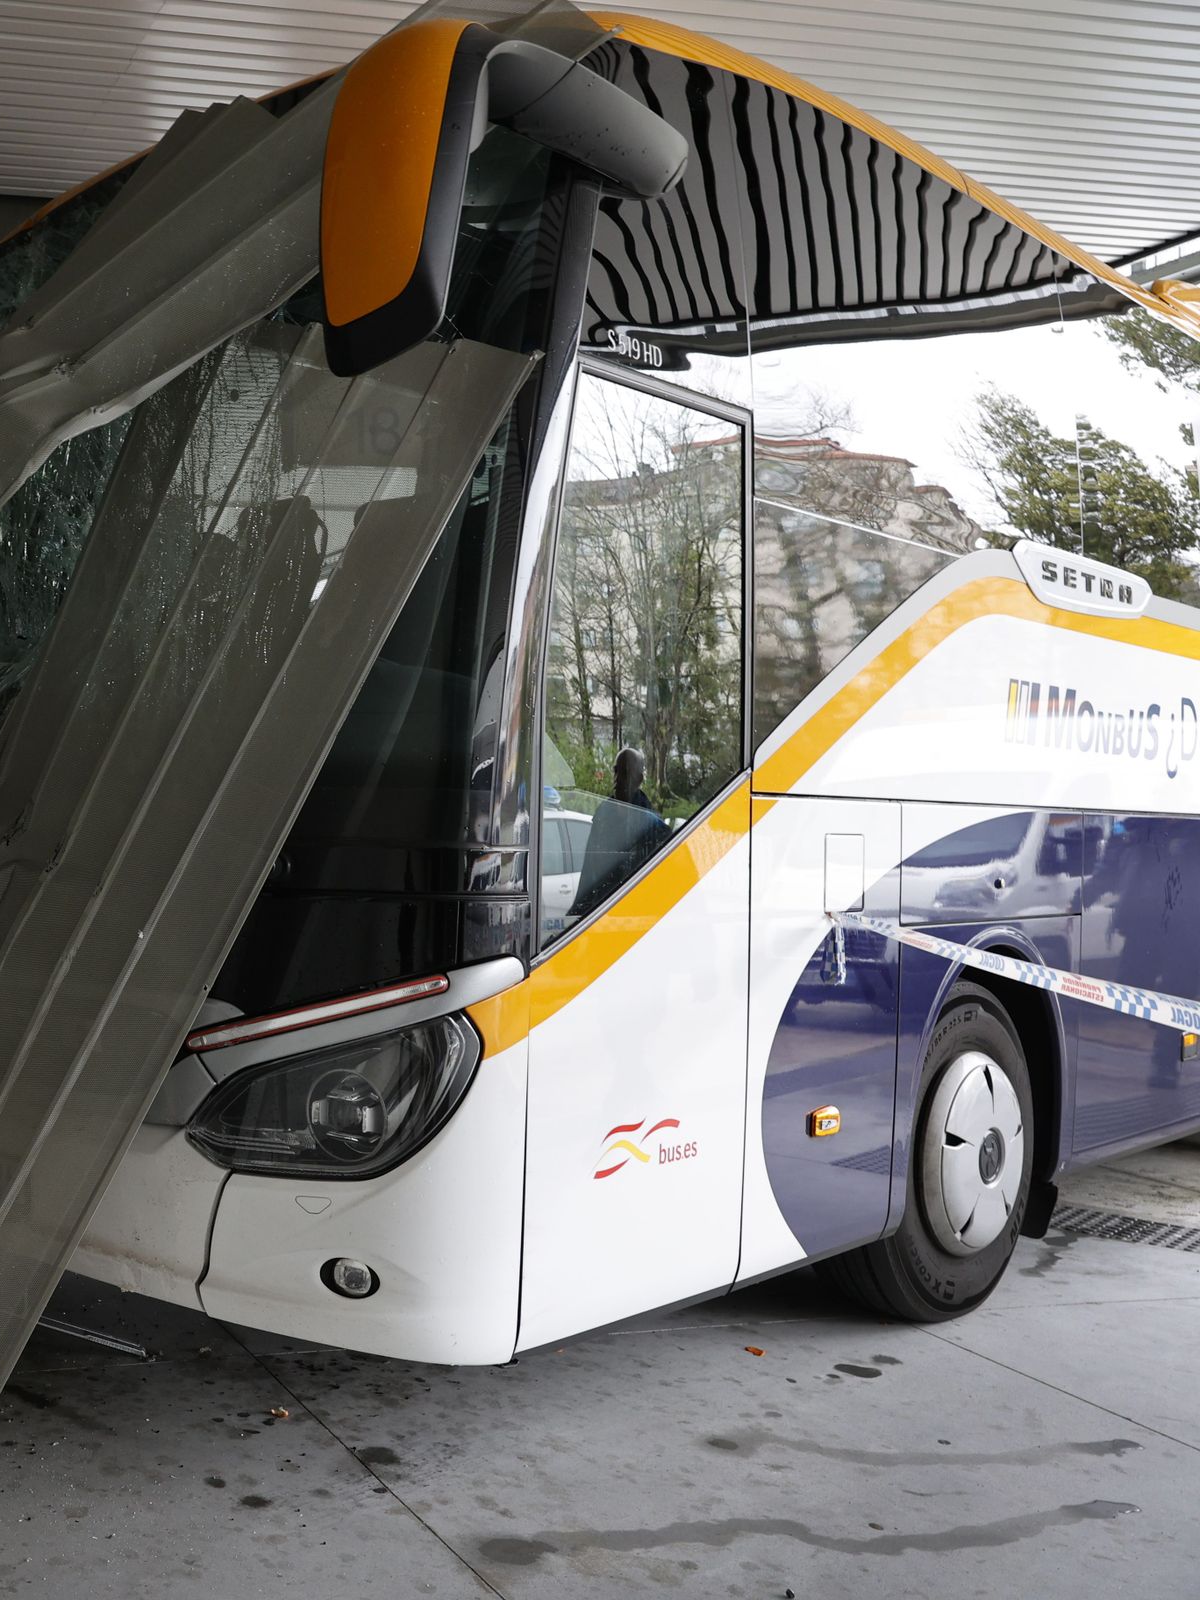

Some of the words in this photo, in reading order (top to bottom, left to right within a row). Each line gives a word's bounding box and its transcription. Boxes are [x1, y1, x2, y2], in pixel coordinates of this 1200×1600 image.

[607, 329, 616, 351] S
[618, 333, 641, 360] 519
[641, 341, 663, 367] HD
[1041, 560, 1133, 605] SETRA
[658, 1141, 697, 1165] bus.es
